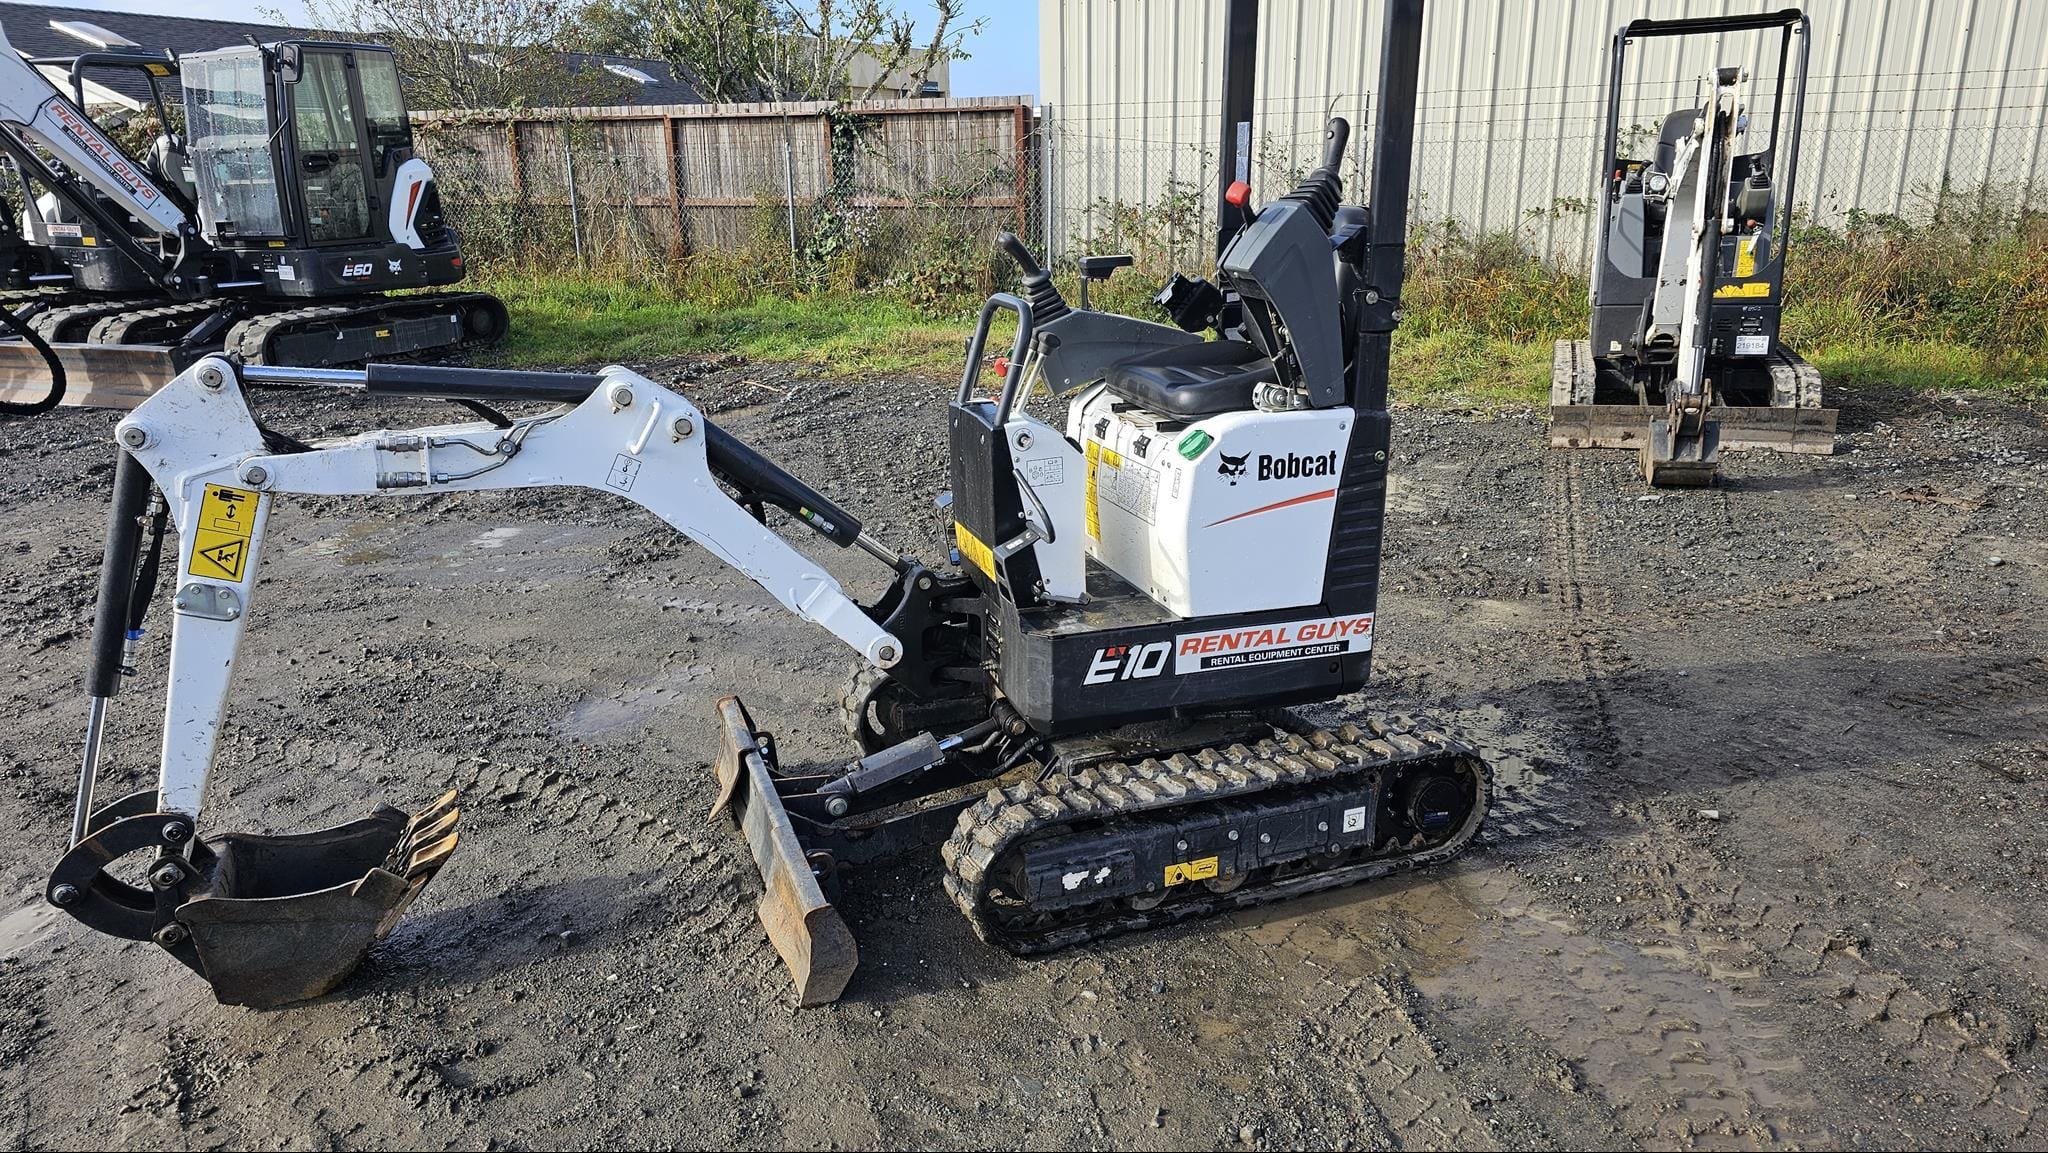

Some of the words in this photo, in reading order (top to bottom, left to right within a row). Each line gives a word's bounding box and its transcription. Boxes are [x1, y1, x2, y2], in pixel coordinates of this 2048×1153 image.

[50, 103, 115, 162] RENTAL
[112, 161, 155, 200] GUYS
[66, 129, 86, 149] RENTAL
[85, 147, 114, 174] EQUIPMENT
[113, 172, 133, 191] CENTER
[343, 263, 373, 277] E60
[1258, 449, 1337, 481] Bobcat
[1179, 627, 1291, 657] RENTAL
[1296, 617, 1372, 642] GUYS
[1210, 655, 1247, 667] RENTAL
[1248, 649, 1303, 662] EQUIPMENT
[1304, 644, 1341, 656] CENTER
[1083, 640, 1173, 686] E10
